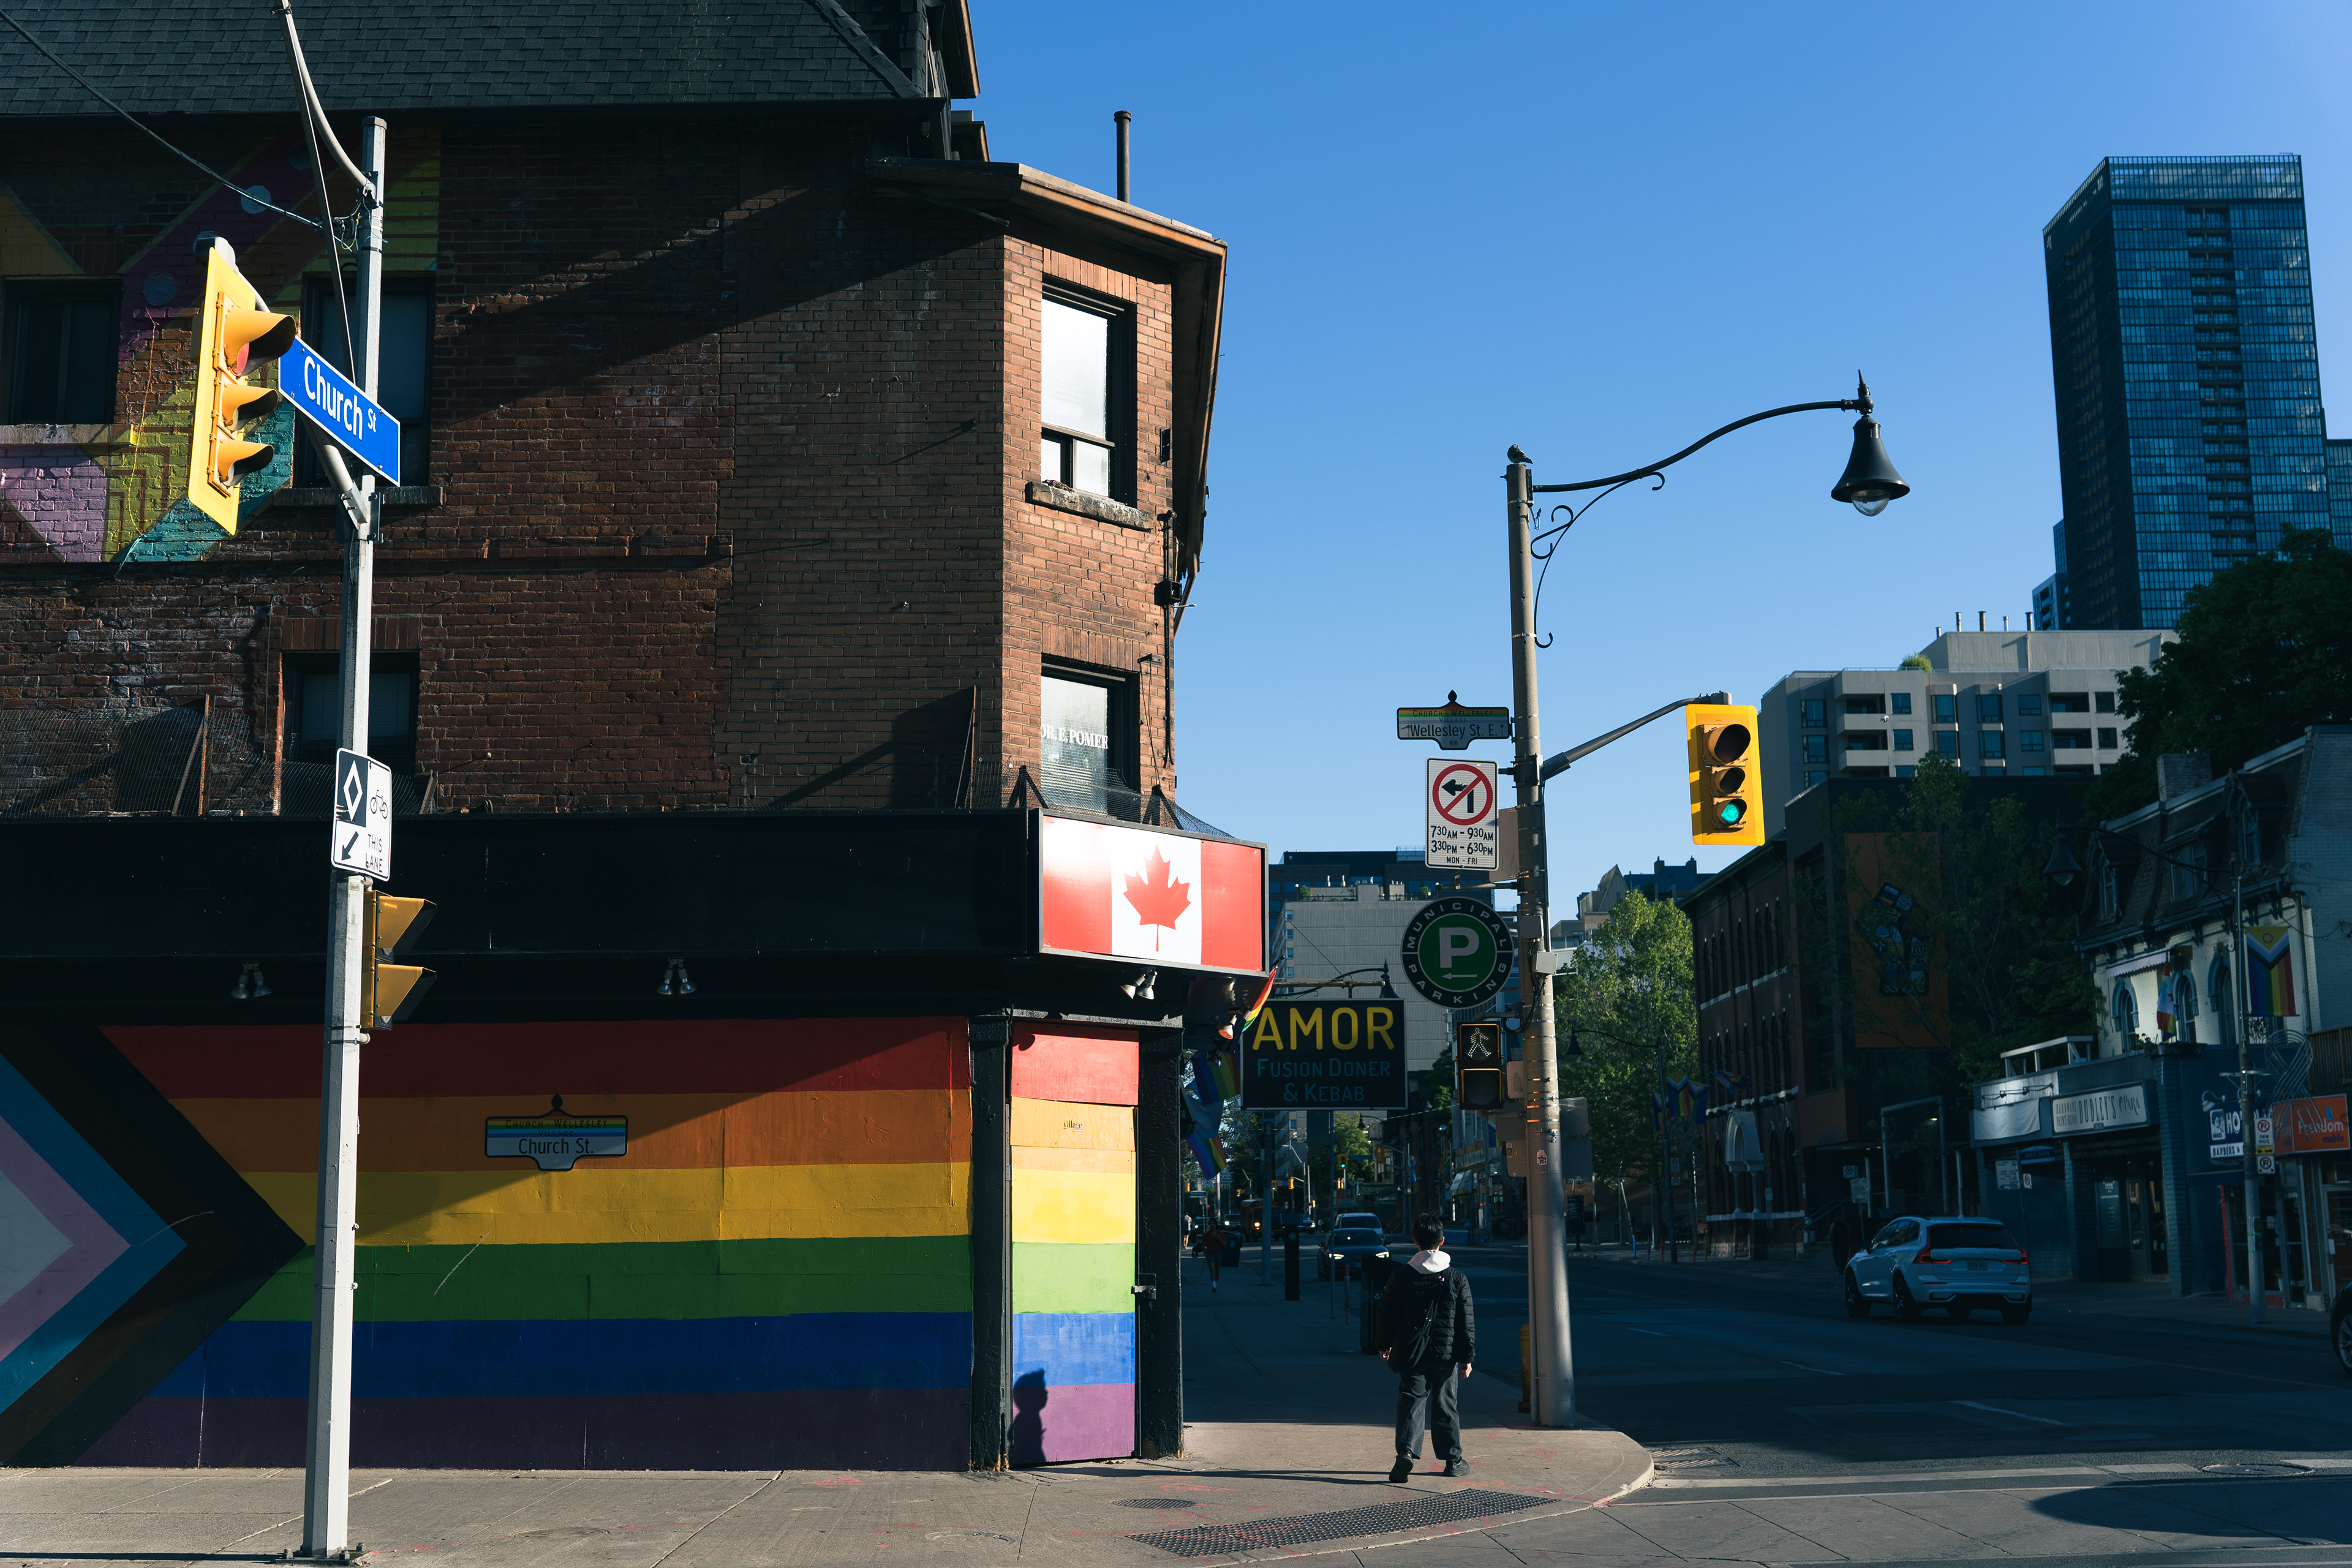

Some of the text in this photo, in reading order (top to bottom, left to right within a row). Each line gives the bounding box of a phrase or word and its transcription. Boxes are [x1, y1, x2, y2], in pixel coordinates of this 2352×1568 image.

[304, 355, 377, 440] Church St
[1410, 723, 1498, 739] Wellesley St. E.
[368, 834, 382, 853] THIS
[365, 852, 383, 873] LANE
[1406, 902, 1507, 949] MUNICIPAL
[1439, 927, 1480, 968] P
[1408, 962, 1507, 1004] PARKING
[1252, 1006, 1395, 1050] AMOR
[1257, 1058, 1391, 1077] FUSION DONER
[1283, 1082, 1365, 1102] & KEBAB
[2079, 1095, 2116, 1123] DUDLEY'S
[505, 1119, 543, 1129] CHURCH
[554, 1118, 608, 1128] WELLESLEY
[518, 1137, 594, 1155] Church St.
[2323, 1133, 2345, 1144] mobile
[2213, 1145, 2235, 1156] BARBERS
